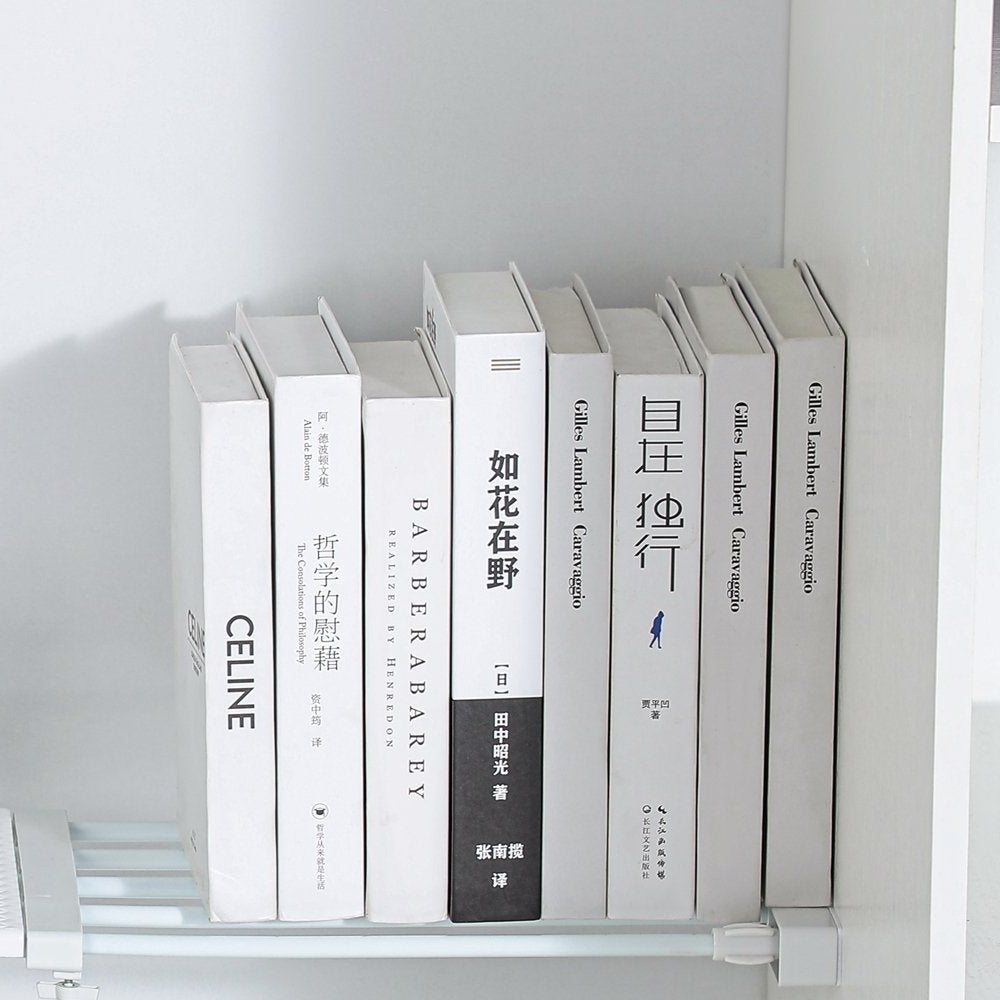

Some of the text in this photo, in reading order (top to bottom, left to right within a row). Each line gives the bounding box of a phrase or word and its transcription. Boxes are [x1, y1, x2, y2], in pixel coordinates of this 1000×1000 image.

[303, 418, 313, 481] Alain de Botton
[568, 399, 589, 609] Gilles Lambert Caravaggio
[635, 396, 684, 592] 自在独行
[726, 401, 749, 613] Gilles Lambert Caravaggio
[799, 382, 823, 594] Gilles Lambert Caravaggio
[487, 450, 519, 589] 如花在野
[295, 542, 308, 665] The Consolations of Philosophy
[313, 534, 340, 671] 哲学的慰藉
[385, 529, 397, 748] REALIZED BY HENREDON
[408, 497, 429, 800] BARBERABAREY
[226, 615, 255, 730] CELINE
[641, 699, 670, 709] 贾平凹
[650, 710, 661, 720] 著
[311, 737, 323, 748] 译
[492, 712, 509, 776] 田中昭光
[492, 783, 509, 801] 著
[475, 842, 525, 861] 张南揽
[491, 872, 508, 889] 译
